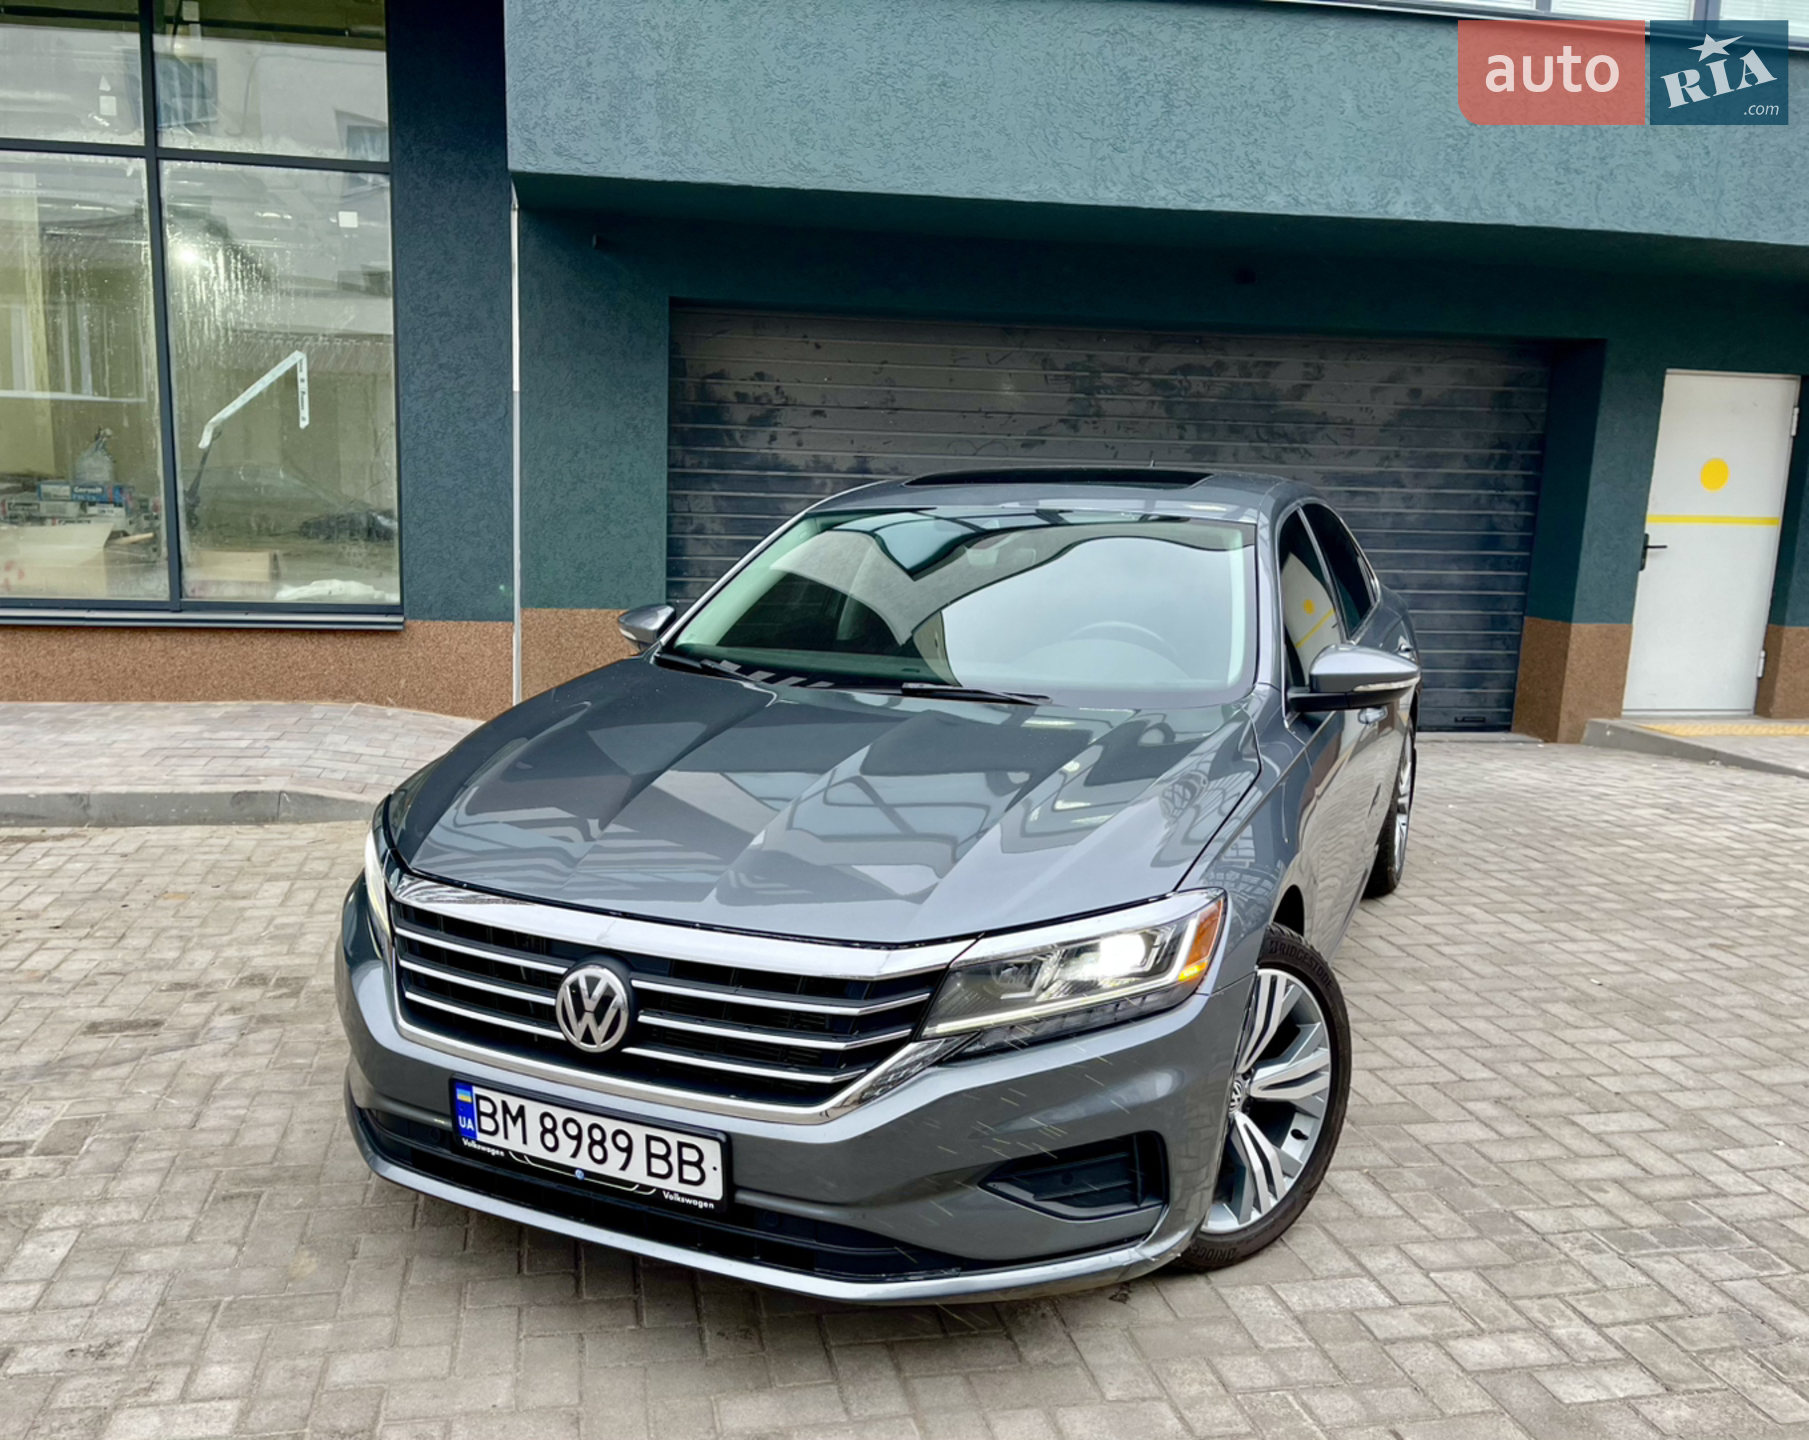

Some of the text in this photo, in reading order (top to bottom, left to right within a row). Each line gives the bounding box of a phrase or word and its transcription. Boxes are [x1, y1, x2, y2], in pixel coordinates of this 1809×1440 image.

[1268, 939, 1333, 989] BRIDGESTONE
[458, 1115, 475, 1131] UA
[462, 1137, 505, 1157] Volkswagen
[474, 1093, 706, 1187] BM 8989 BB
[662, 1190, 715, 1209] Volkswagen
